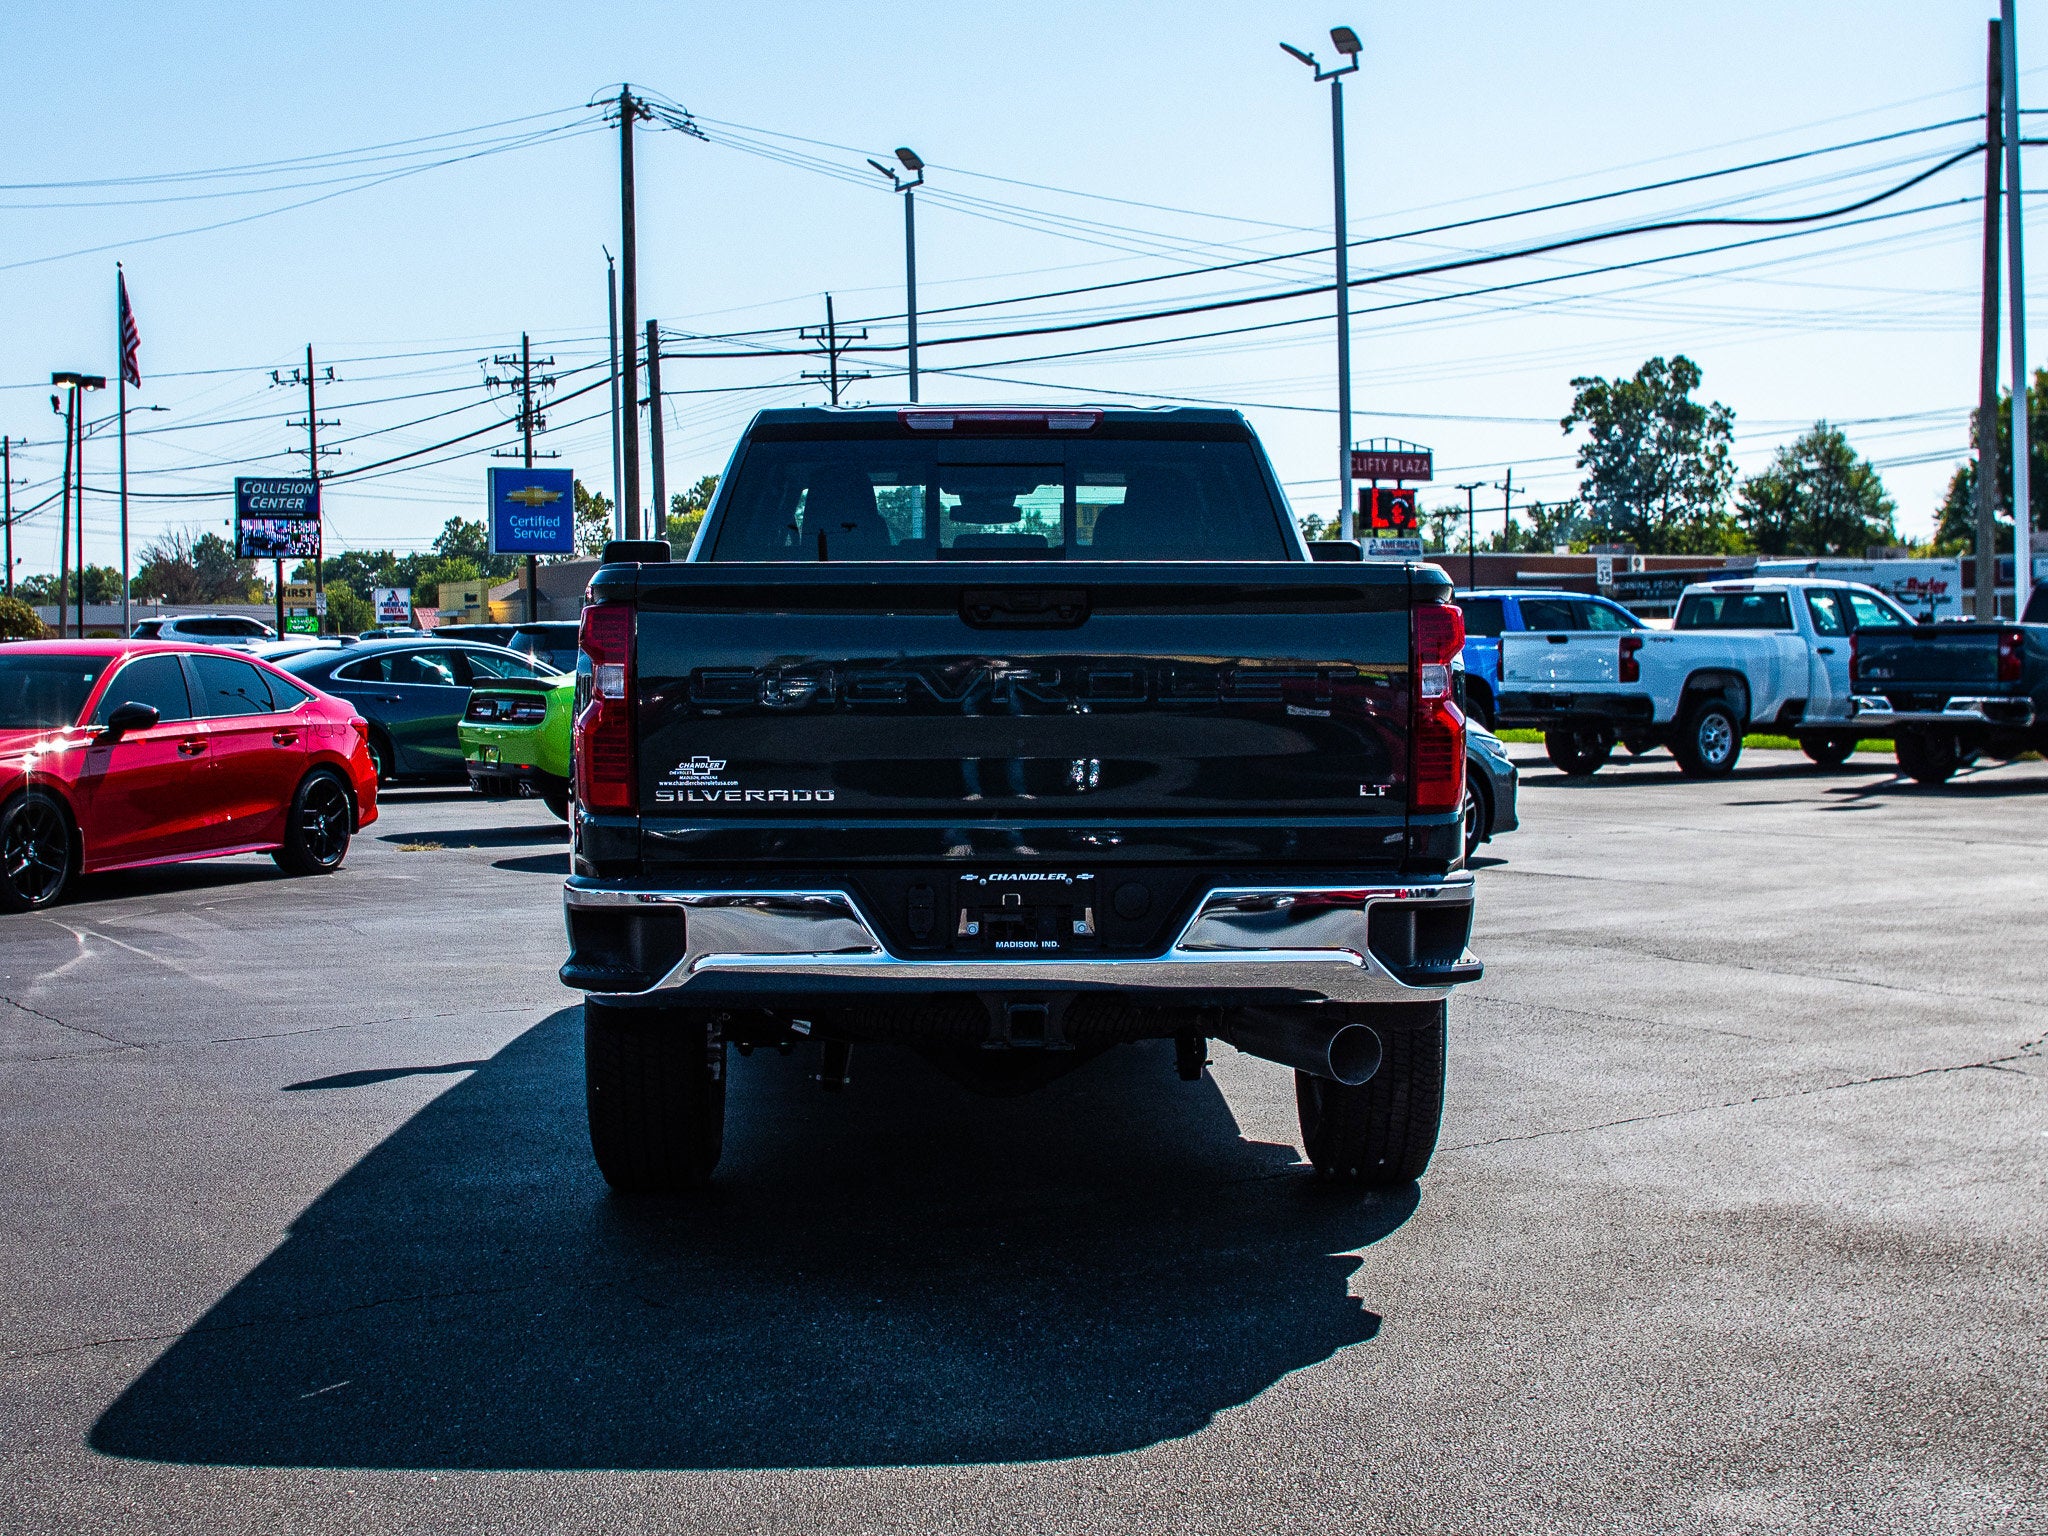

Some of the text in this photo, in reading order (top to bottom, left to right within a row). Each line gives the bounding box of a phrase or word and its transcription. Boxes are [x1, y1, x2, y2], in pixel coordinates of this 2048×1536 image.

[1393, 459, 1429, 473] PLAZA
[242, 481, 315, 494] COLLISION
[249, 496, 305, 509] CENTER
[509, 515, 560, 527] Certified
[514, 527, 556, 539] Service
[656, 789, 835, 802] SILVERADO
[1360, 784, 1391, 796] LT
[988, 873, 1067, 881] CHANDLER
